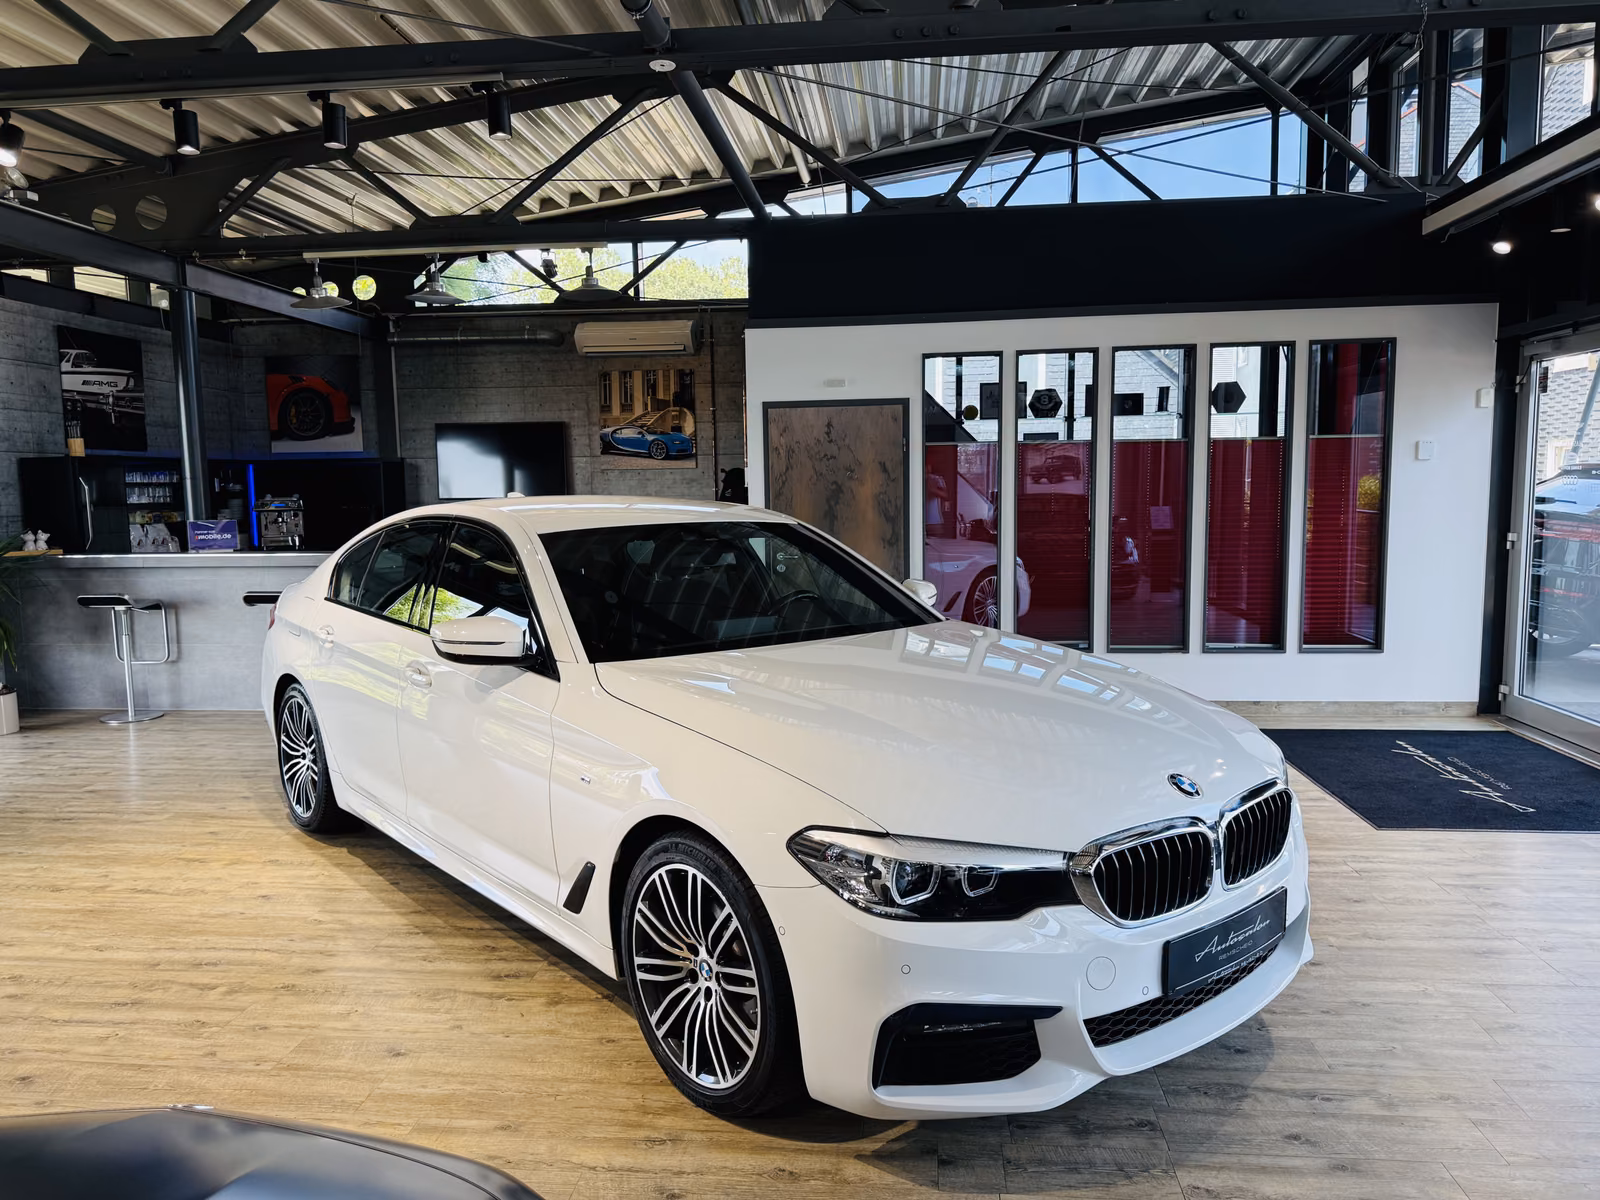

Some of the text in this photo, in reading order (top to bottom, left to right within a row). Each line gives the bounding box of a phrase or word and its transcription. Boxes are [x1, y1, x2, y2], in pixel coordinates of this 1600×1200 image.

[92, 380, 118, 388] AMG
[678, 842, 718, 871] MICHELIN
[1195, 915, 1270, 962] Autosalon
